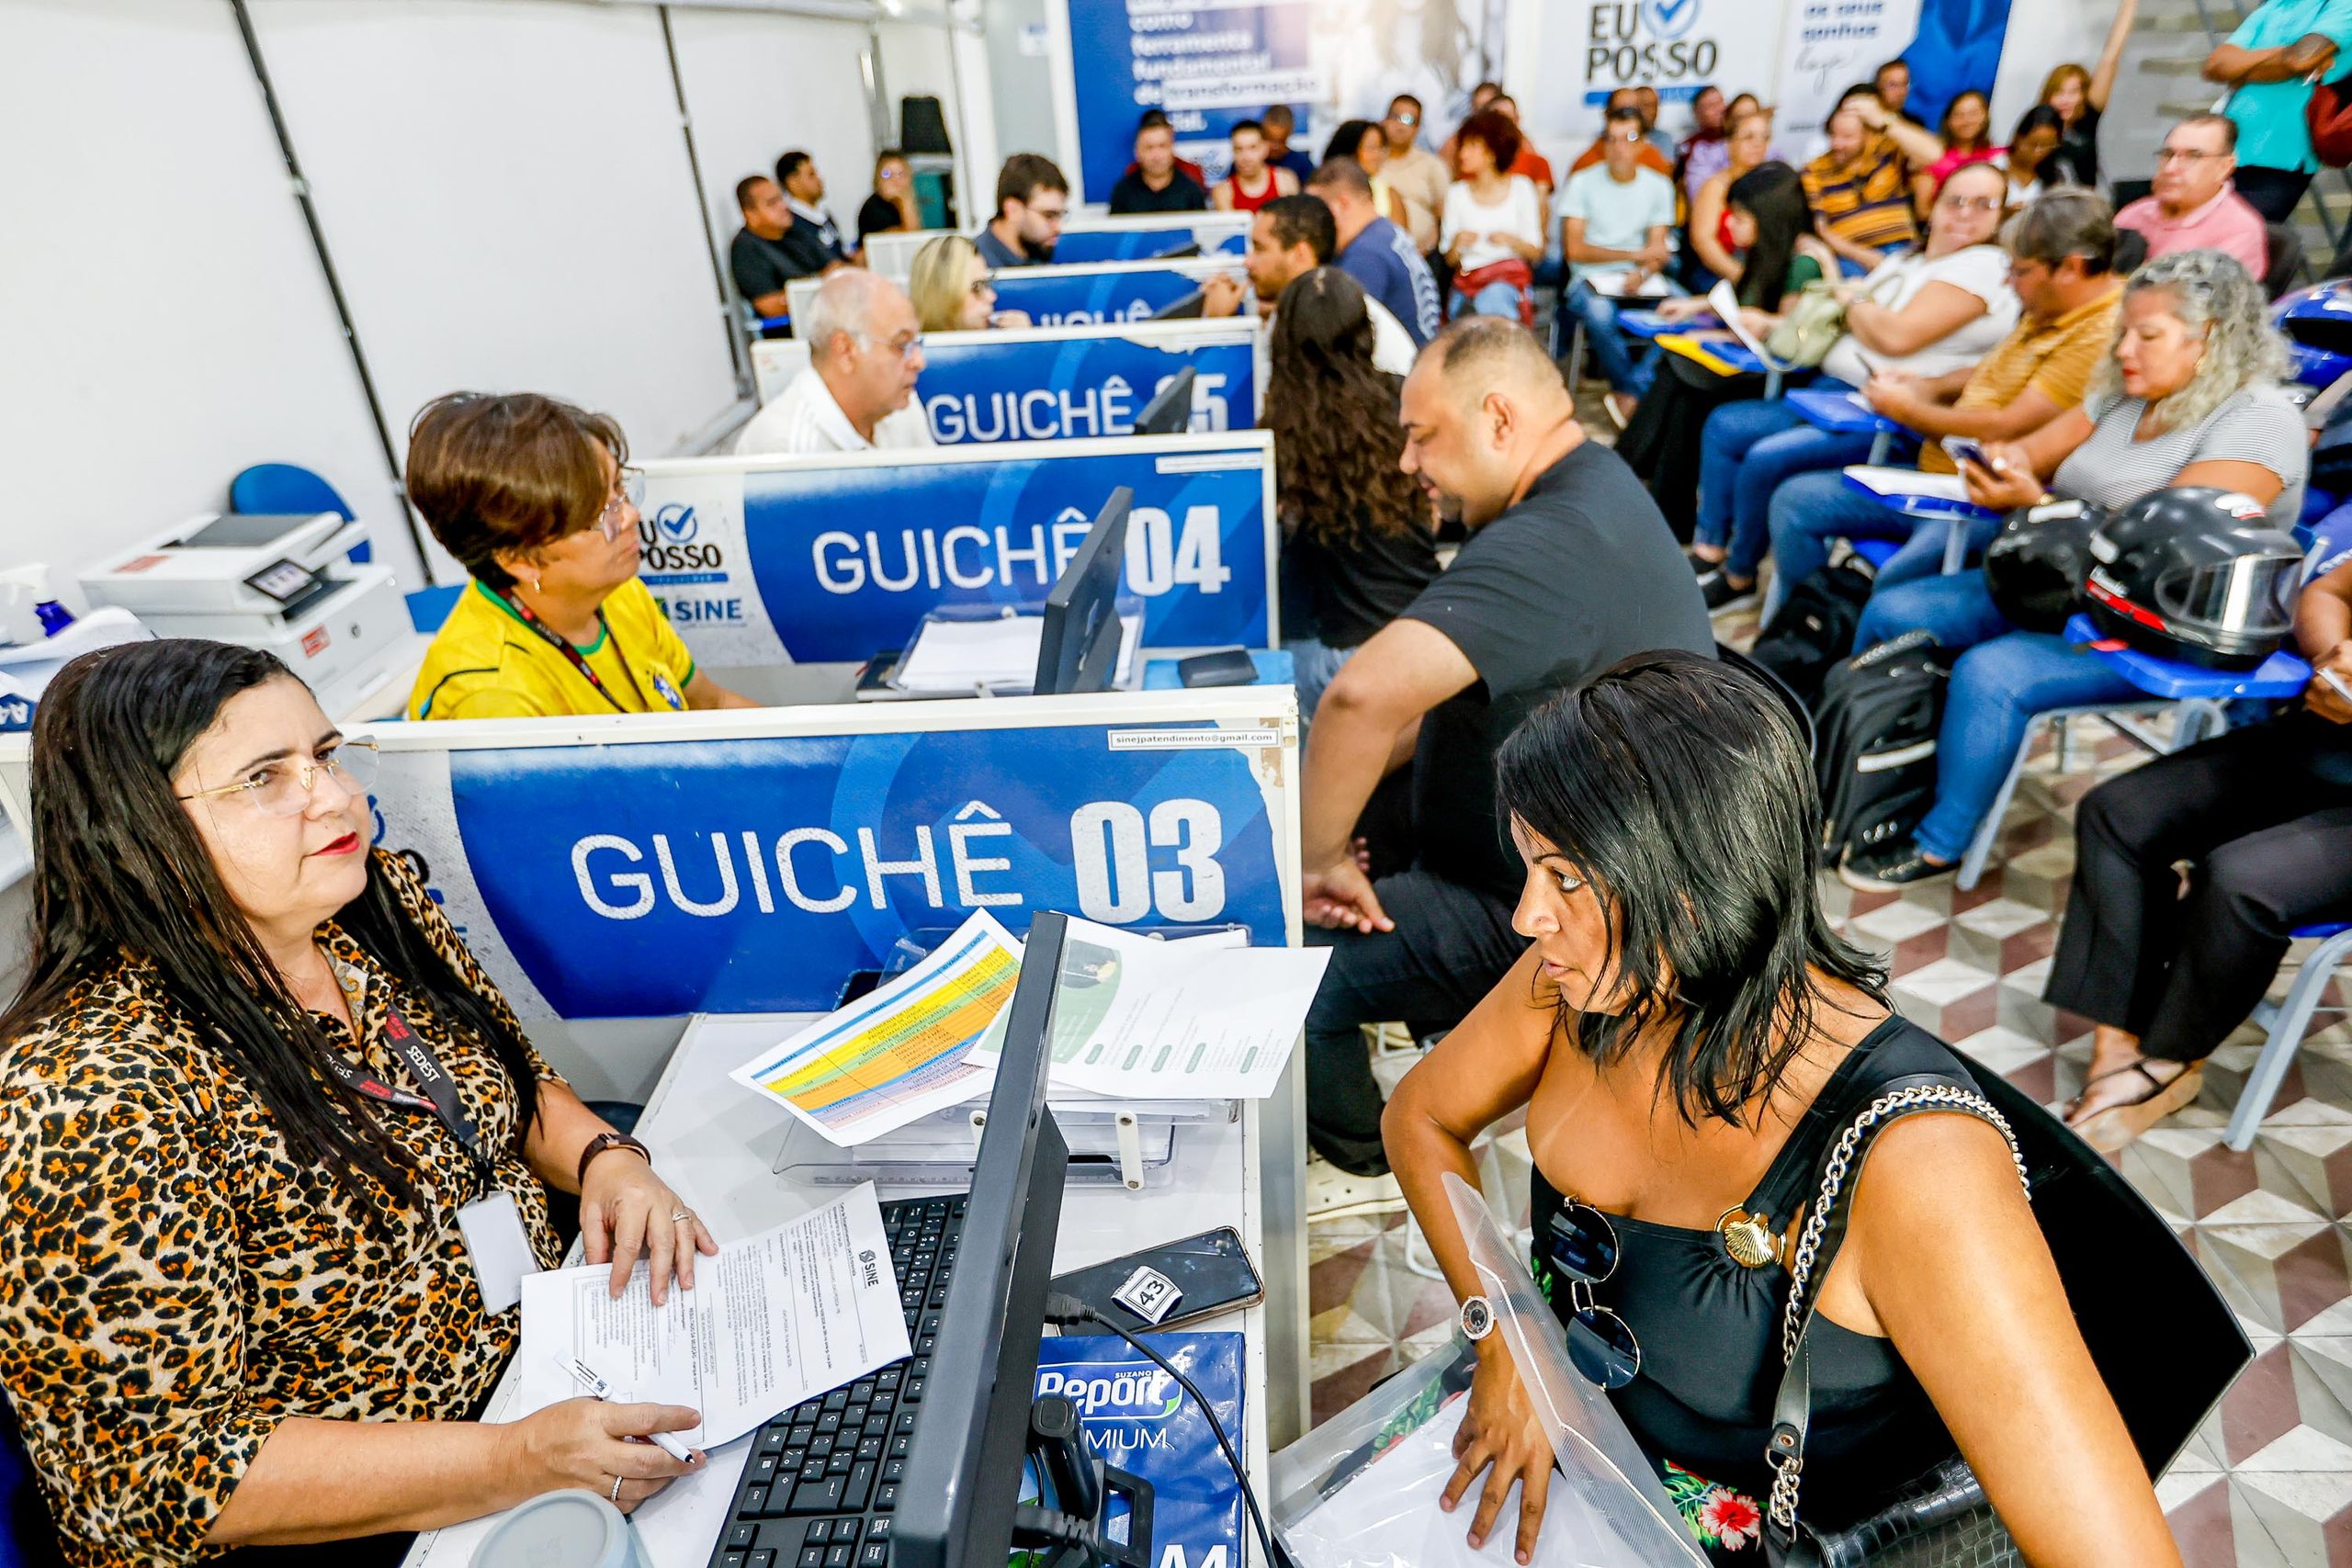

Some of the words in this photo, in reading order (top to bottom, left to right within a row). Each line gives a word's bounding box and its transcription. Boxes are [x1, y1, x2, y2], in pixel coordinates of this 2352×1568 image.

[1591, 4, 1638, 39] EU
[1587, 40, 1717, 82] POSSO
[926, 375, 1135, 444] GUICHÊ
[811, 507, 1093, 595] GUICHÊ
[1124, 503, 1231, 597] 04
[674, 598, 742, 621] SINE
[1116, 733, 1272, 746] sinejpatendimento@gmail.com
[571, 798, 1024, 919] GUICHÊ
[1069, 797, 1226, 923] 03
[768, 1052, 797, 1071] EMPRESAS
[868, 1002, 887, 1015] VAGAS
[406, 1044, 441, 1082] SEDEST
[910, 1055, 941, 1074] OPERADOR
[939, 1040, 968, 1058] COMERCIAL
[864, 1262, 878, 1287] SINE
[1140, 1280, 1165, 1305] 43
[1086, 1427, 1168, 1450] MIUM
